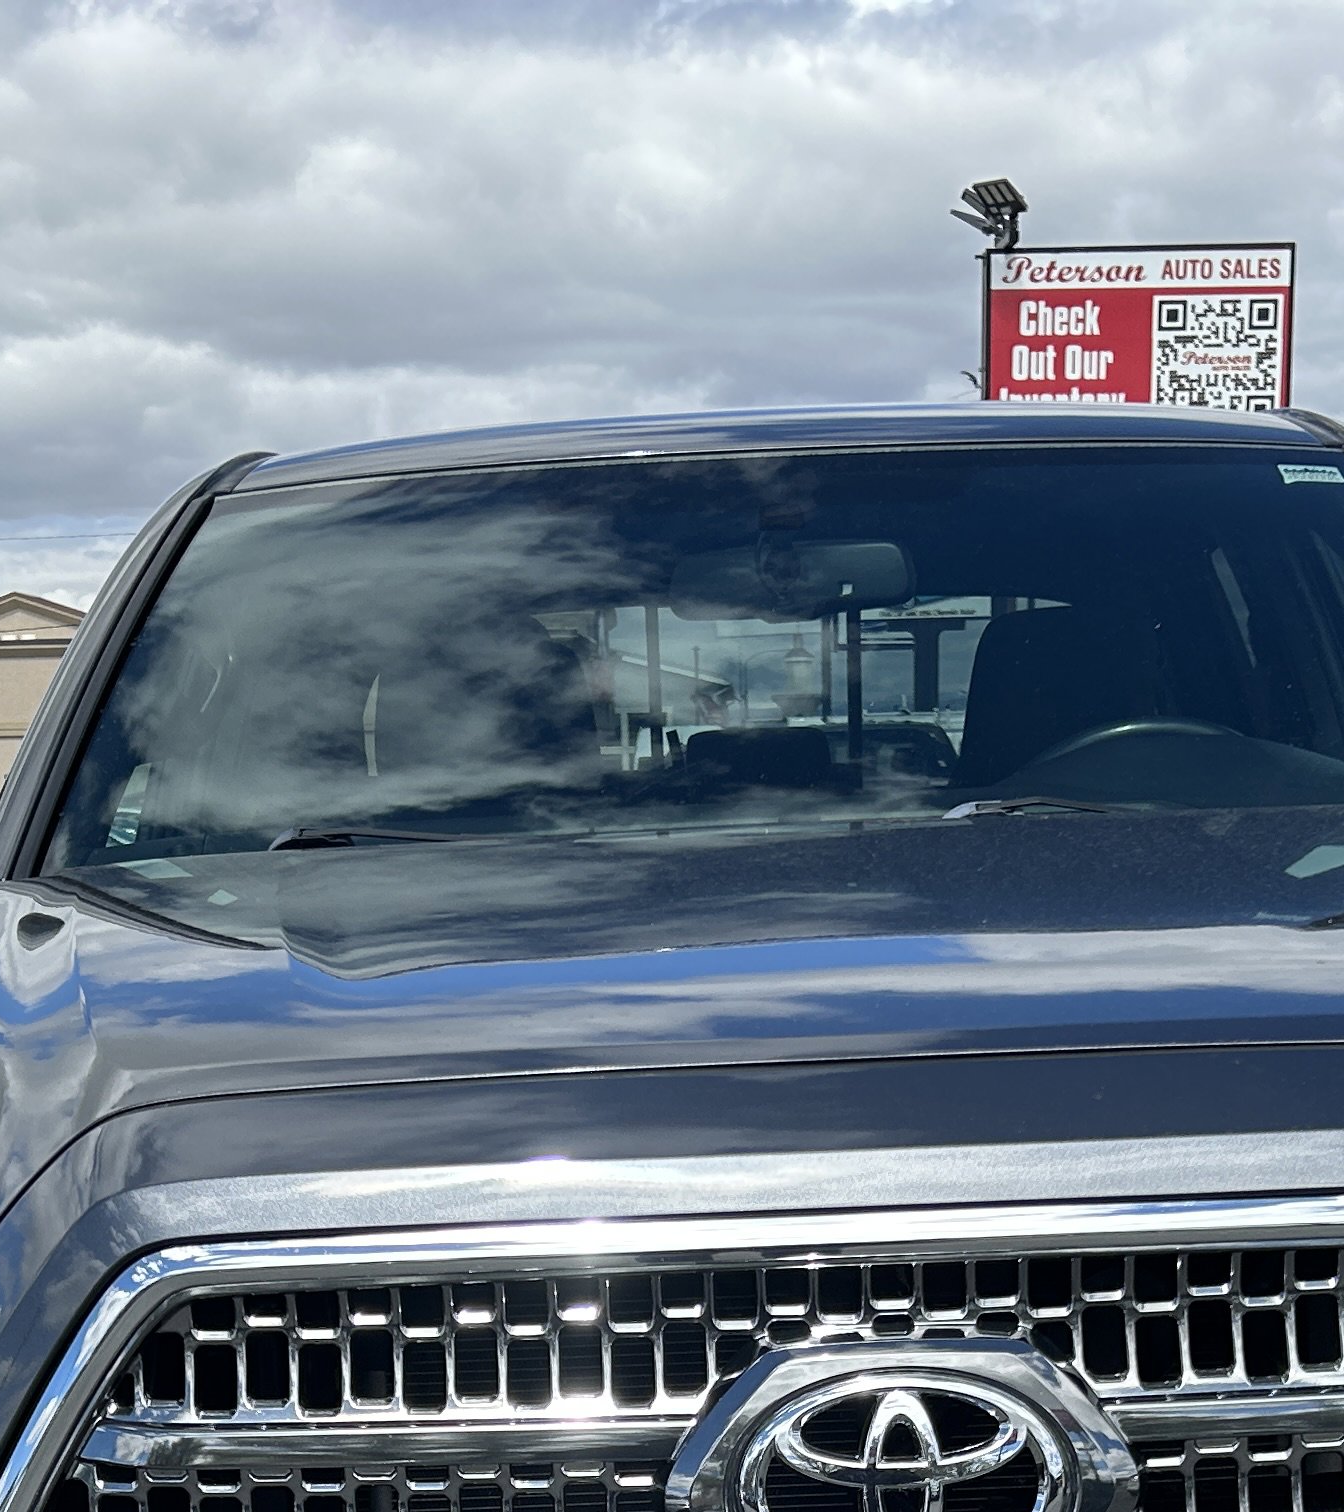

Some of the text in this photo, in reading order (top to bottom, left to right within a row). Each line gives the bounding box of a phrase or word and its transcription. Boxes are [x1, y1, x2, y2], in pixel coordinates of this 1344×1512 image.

[1002, 256, 1281, 283] Peterson AUTO SALES
[1019, 299, 1101, 337] Check
[1011, 344, 1115, 381] Out Our
